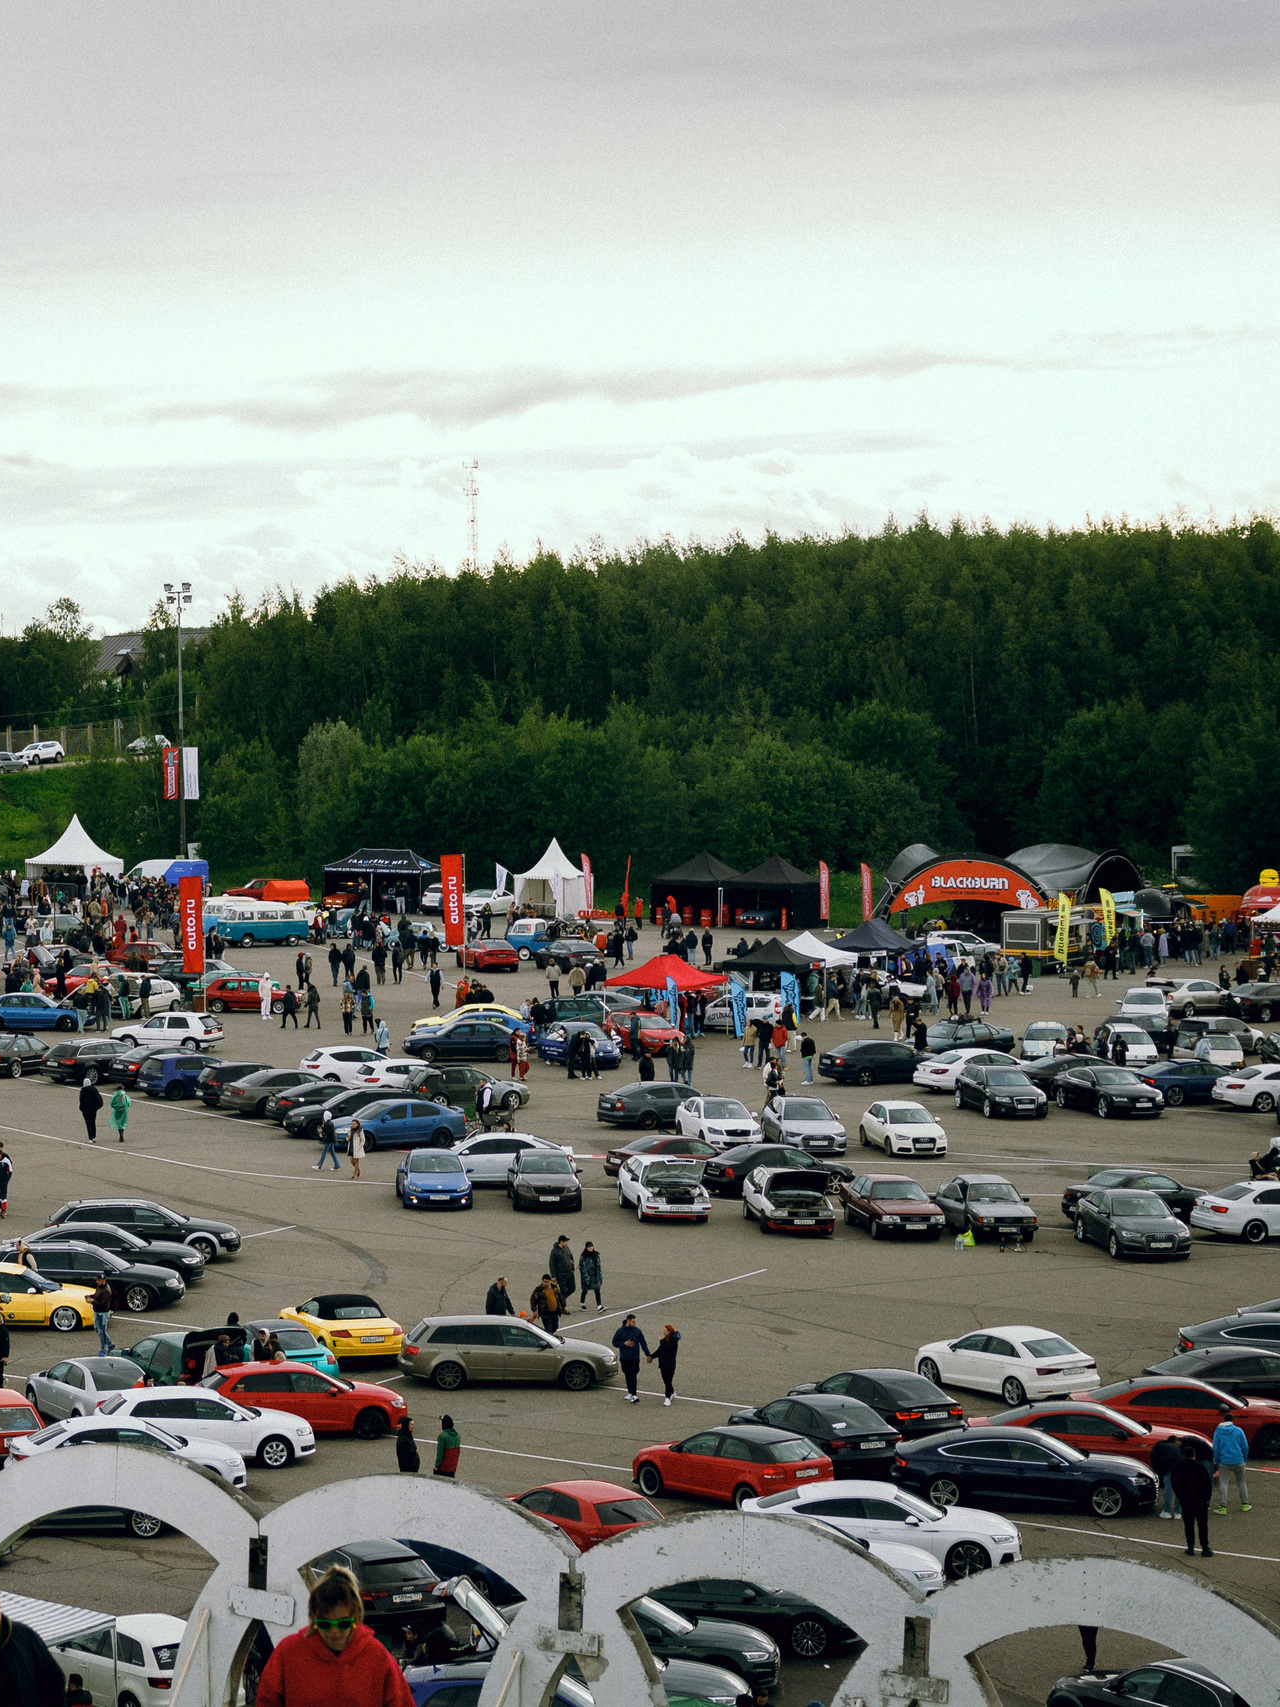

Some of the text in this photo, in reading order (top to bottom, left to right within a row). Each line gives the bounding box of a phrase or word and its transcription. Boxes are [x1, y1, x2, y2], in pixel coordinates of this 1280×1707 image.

[931, 876, 1009, 890] BLACKBURN
[448, 876, 459, 924] auto.ru
[578, 909, 616, 919] auto.r
[186, 899, 197, 950] auto.ru
